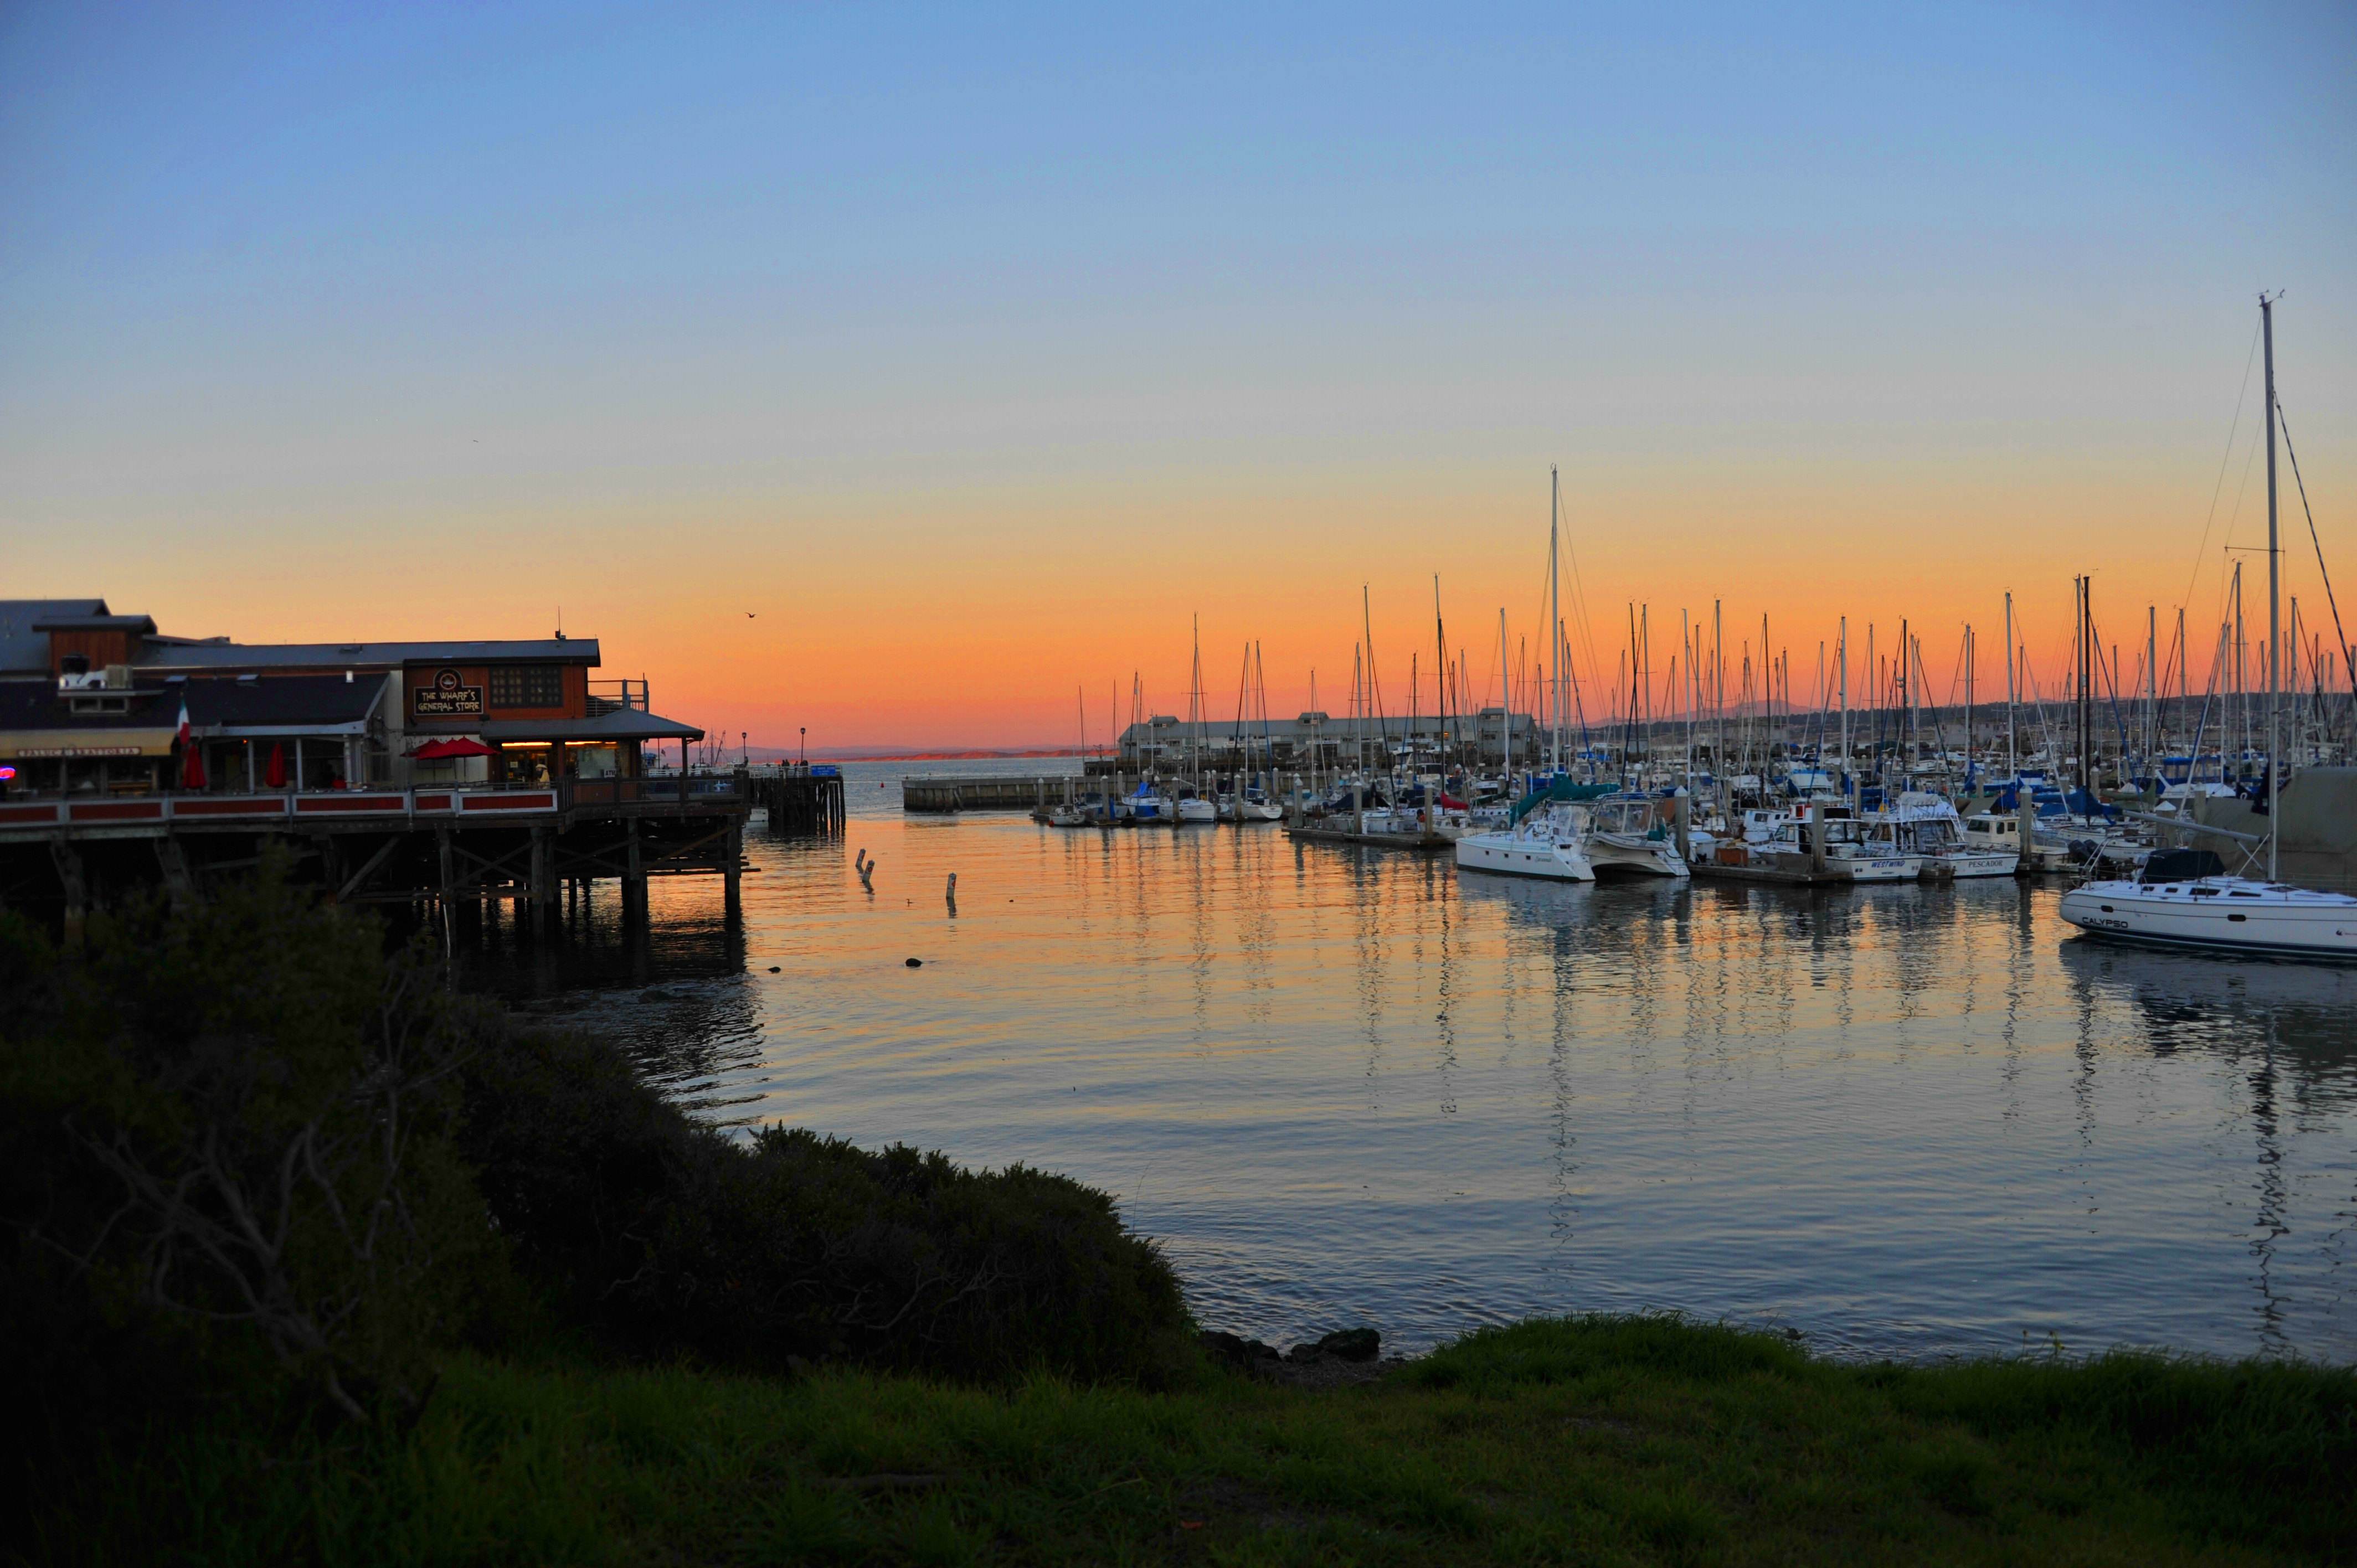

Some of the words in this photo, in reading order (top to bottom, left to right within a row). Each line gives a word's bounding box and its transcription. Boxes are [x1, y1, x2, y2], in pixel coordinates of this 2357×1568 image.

[423, 692, 436, 701] THE
[440, 689, 476, 701] WHARF'S
[418, 703, 453, 711] GENERAL
[456, 702, 480, 711] STORE
[1968, 860, 2003, 868] PESCADOR
[2082, 917, 2128, 929] CALYPSO
